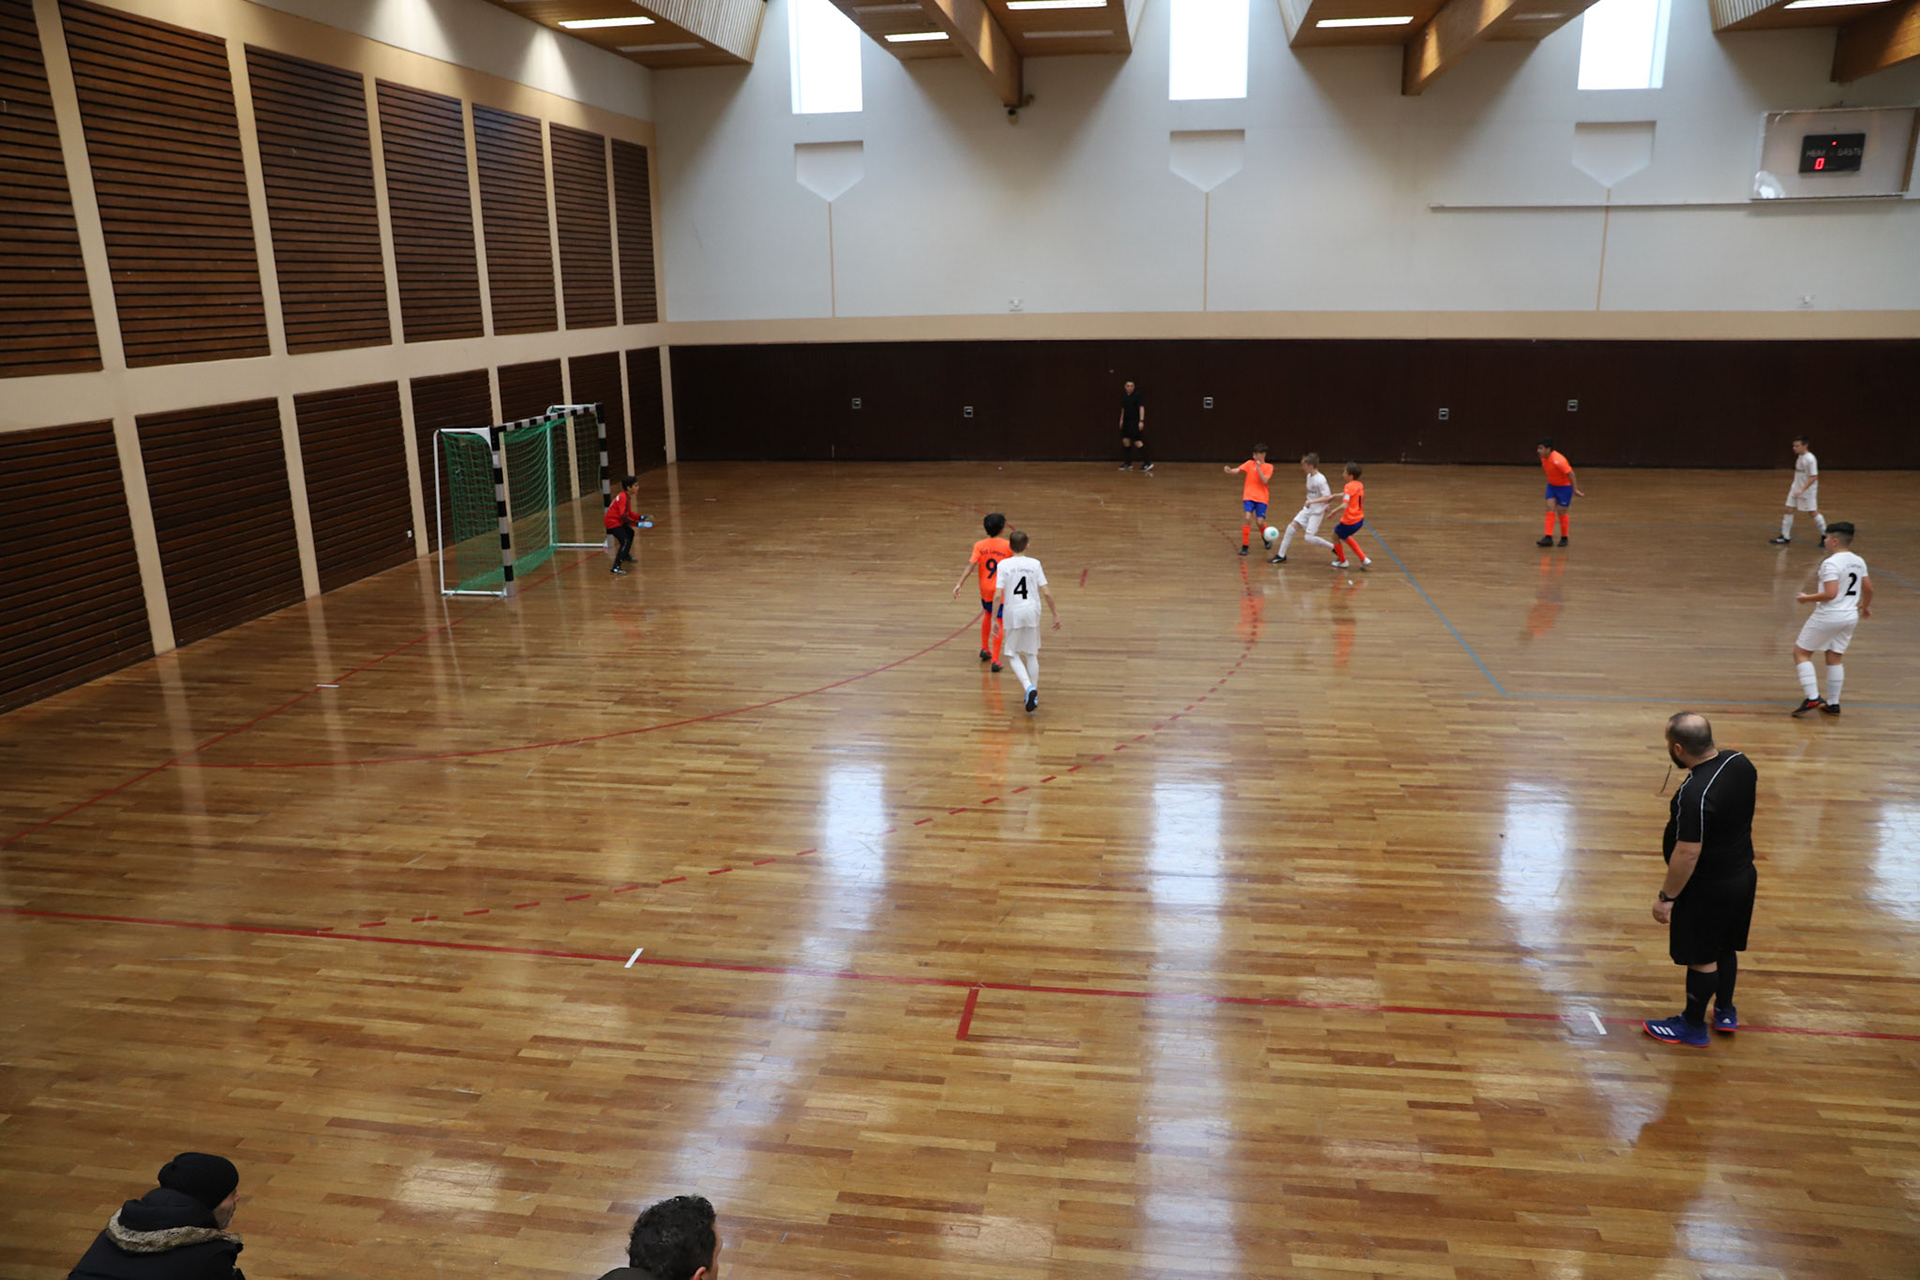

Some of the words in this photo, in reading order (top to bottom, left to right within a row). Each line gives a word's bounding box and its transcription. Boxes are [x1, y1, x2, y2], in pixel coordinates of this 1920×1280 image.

[1814, 157, 1825, 170] 0
[986, 558, 997, 579] 9
[1013, 575, 1028, 600] 4
[1844, 572, 1857, 597] 2
